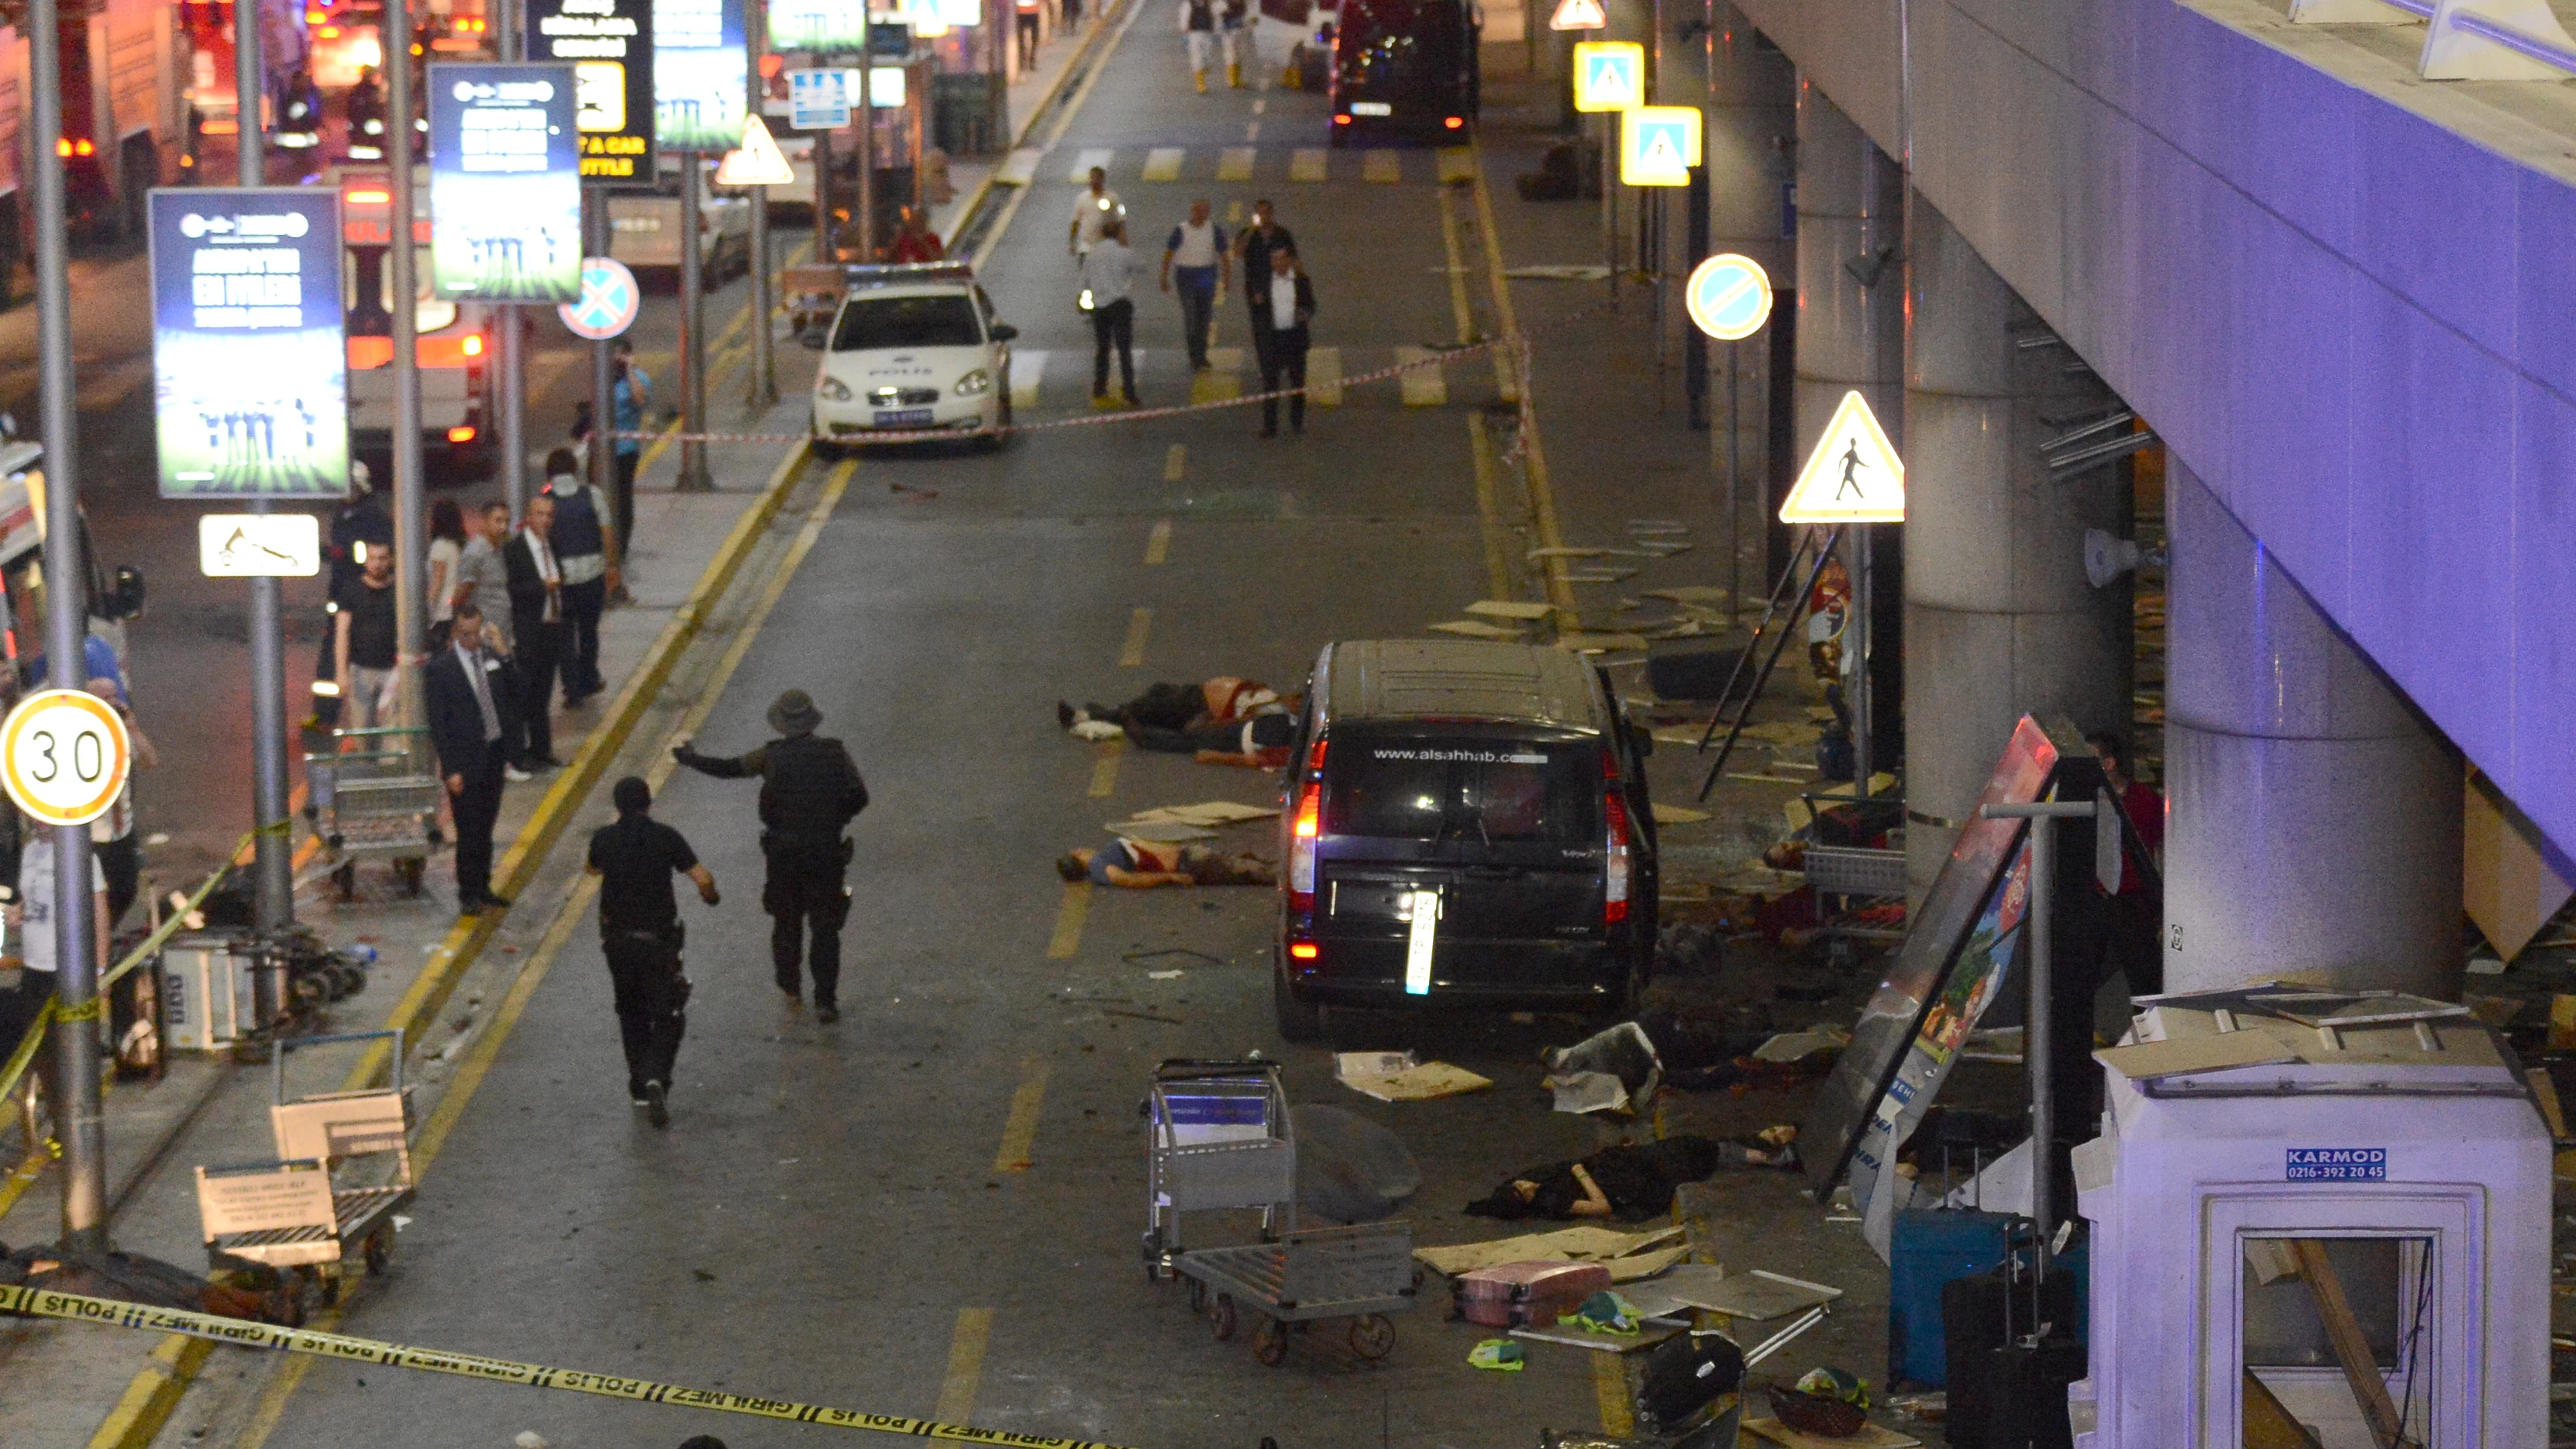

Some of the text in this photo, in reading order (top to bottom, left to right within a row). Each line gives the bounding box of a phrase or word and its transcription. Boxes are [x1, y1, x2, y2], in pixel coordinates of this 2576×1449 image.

[32, 730, 102, 783] 30
[2288, 1151, 2384, 1163] KARMOD
[2350, 1167, 2365, 1177] 20
[2368, 1167, 2384, 1177] 45
